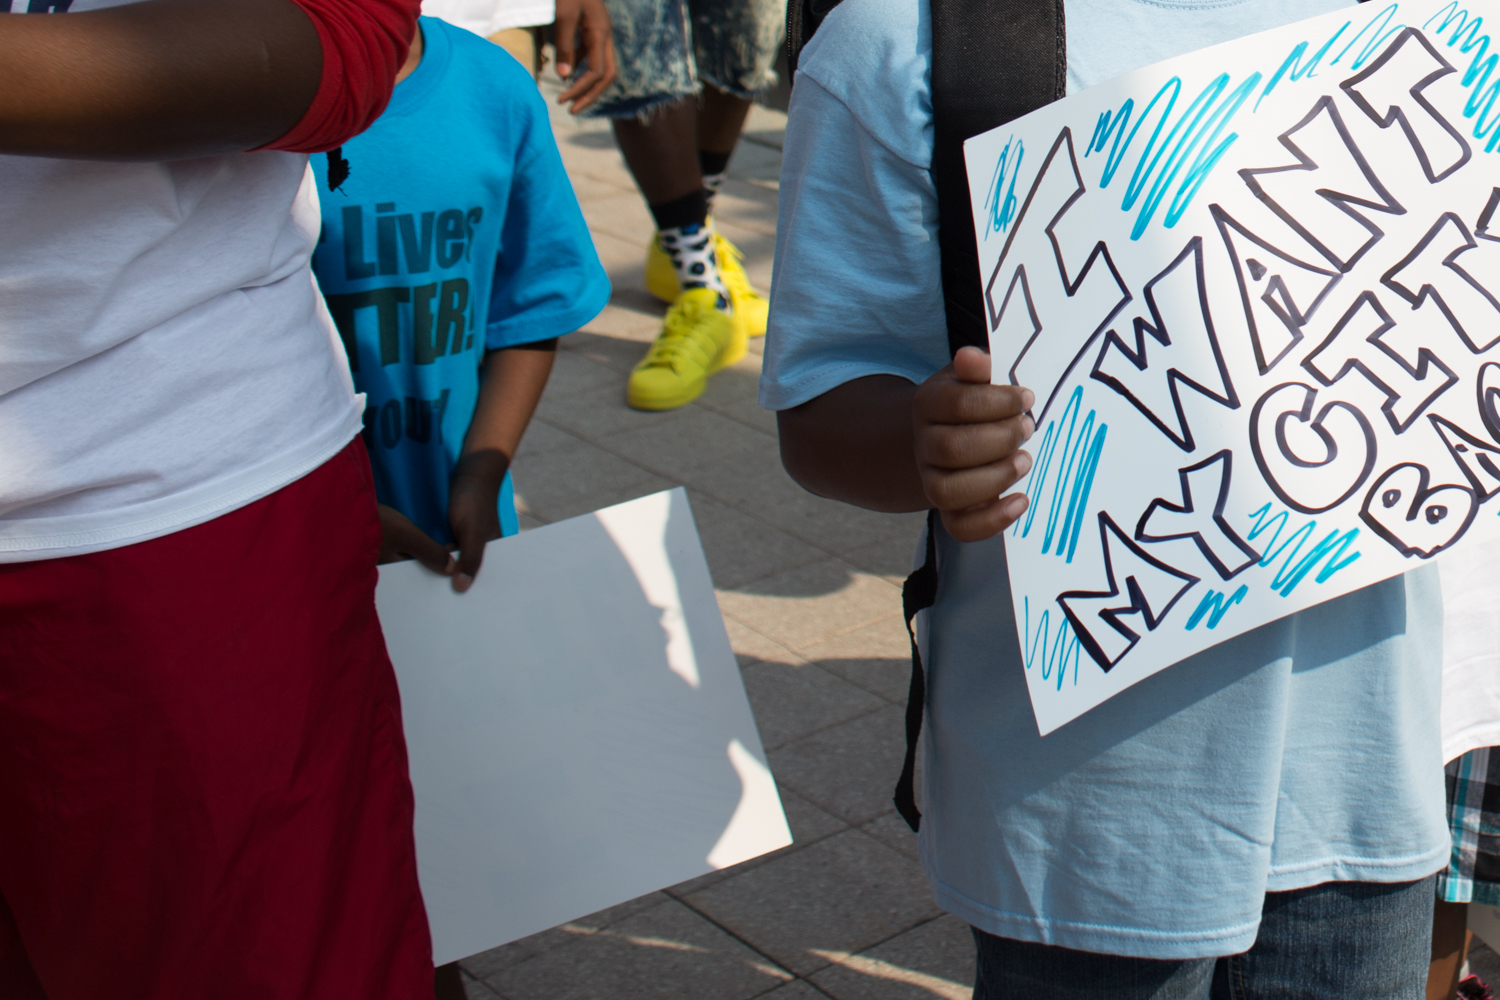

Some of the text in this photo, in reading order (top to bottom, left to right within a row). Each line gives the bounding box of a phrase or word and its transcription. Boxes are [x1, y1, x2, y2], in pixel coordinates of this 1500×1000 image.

[985, 26, 1473, 453] I WANT
[1056, 448, 1263, 673] MY
